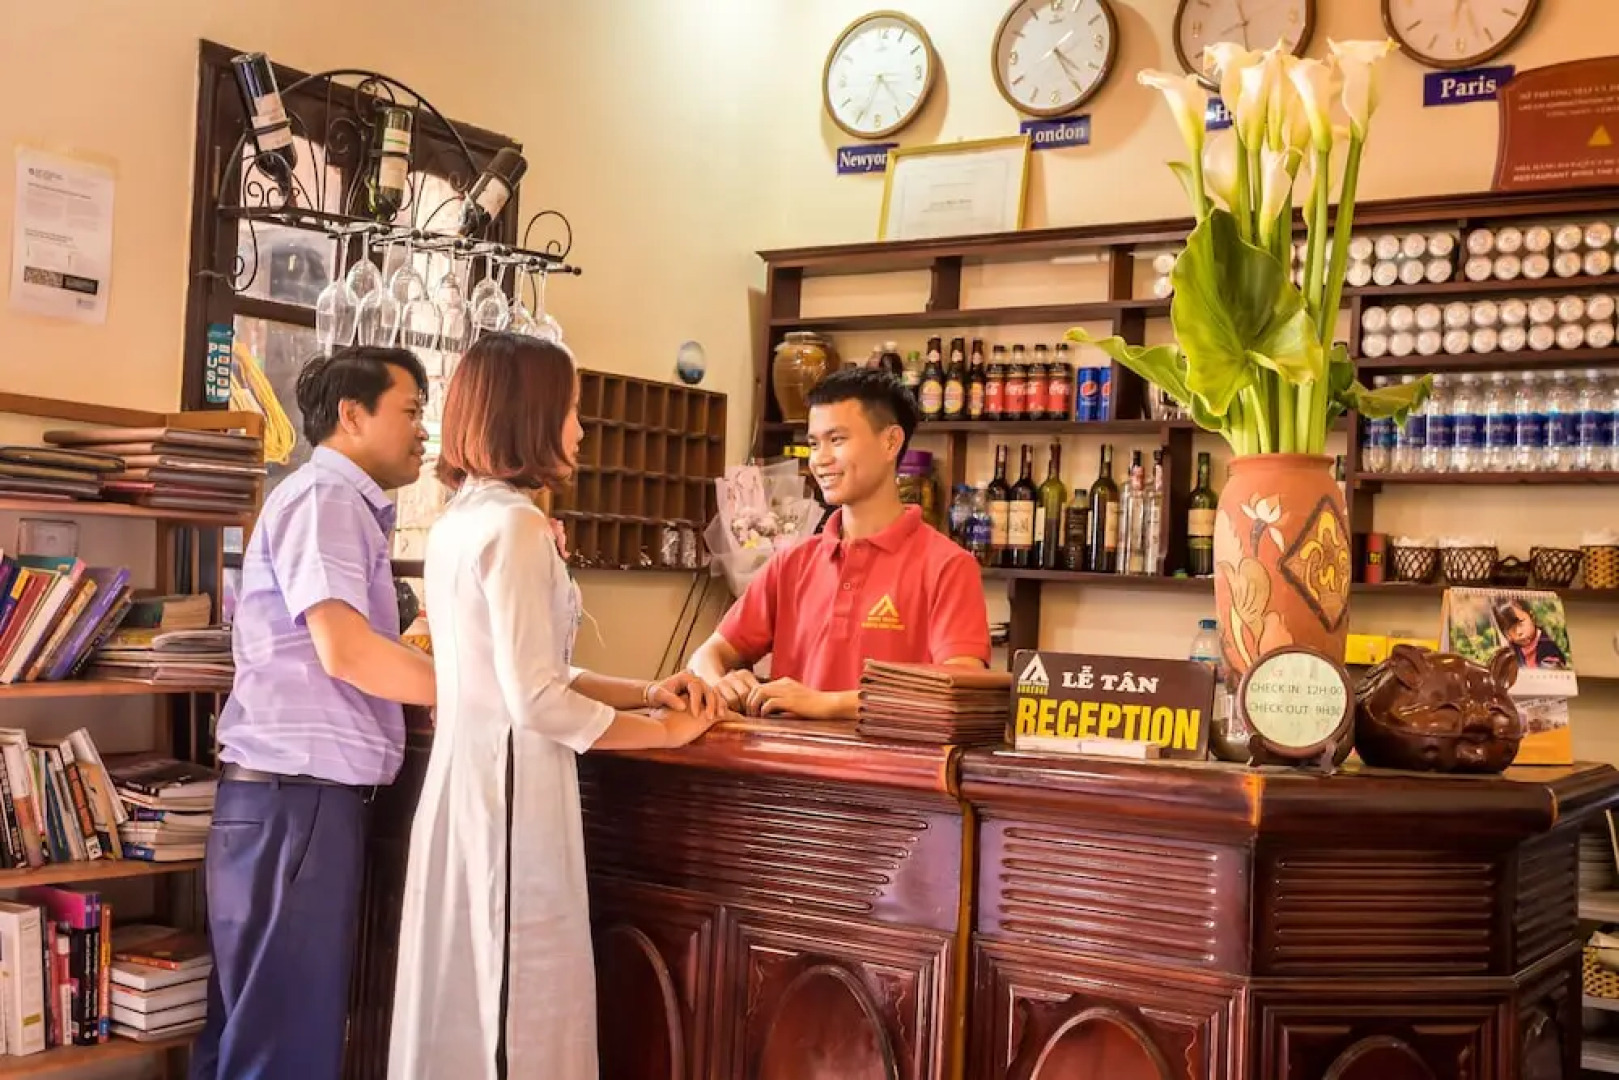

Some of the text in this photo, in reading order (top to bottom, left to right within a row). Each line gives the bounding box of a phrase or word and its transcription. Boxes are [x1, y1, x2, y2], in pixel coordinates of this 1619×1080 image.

[1440, 76, 1497, 98] Paris
[840, 151, 888, 171] Newyor
[206, 342, 218, 397] PUSH
[1061, 665, 1094, 690] LỄ
[1100, 671, 1159, 694] TÂN
[1250, 682, 1284, 694] CHECK
[1250, 702, 1284, 714] CHECK
[1016, 697, 1201, 751] RECEPTION
